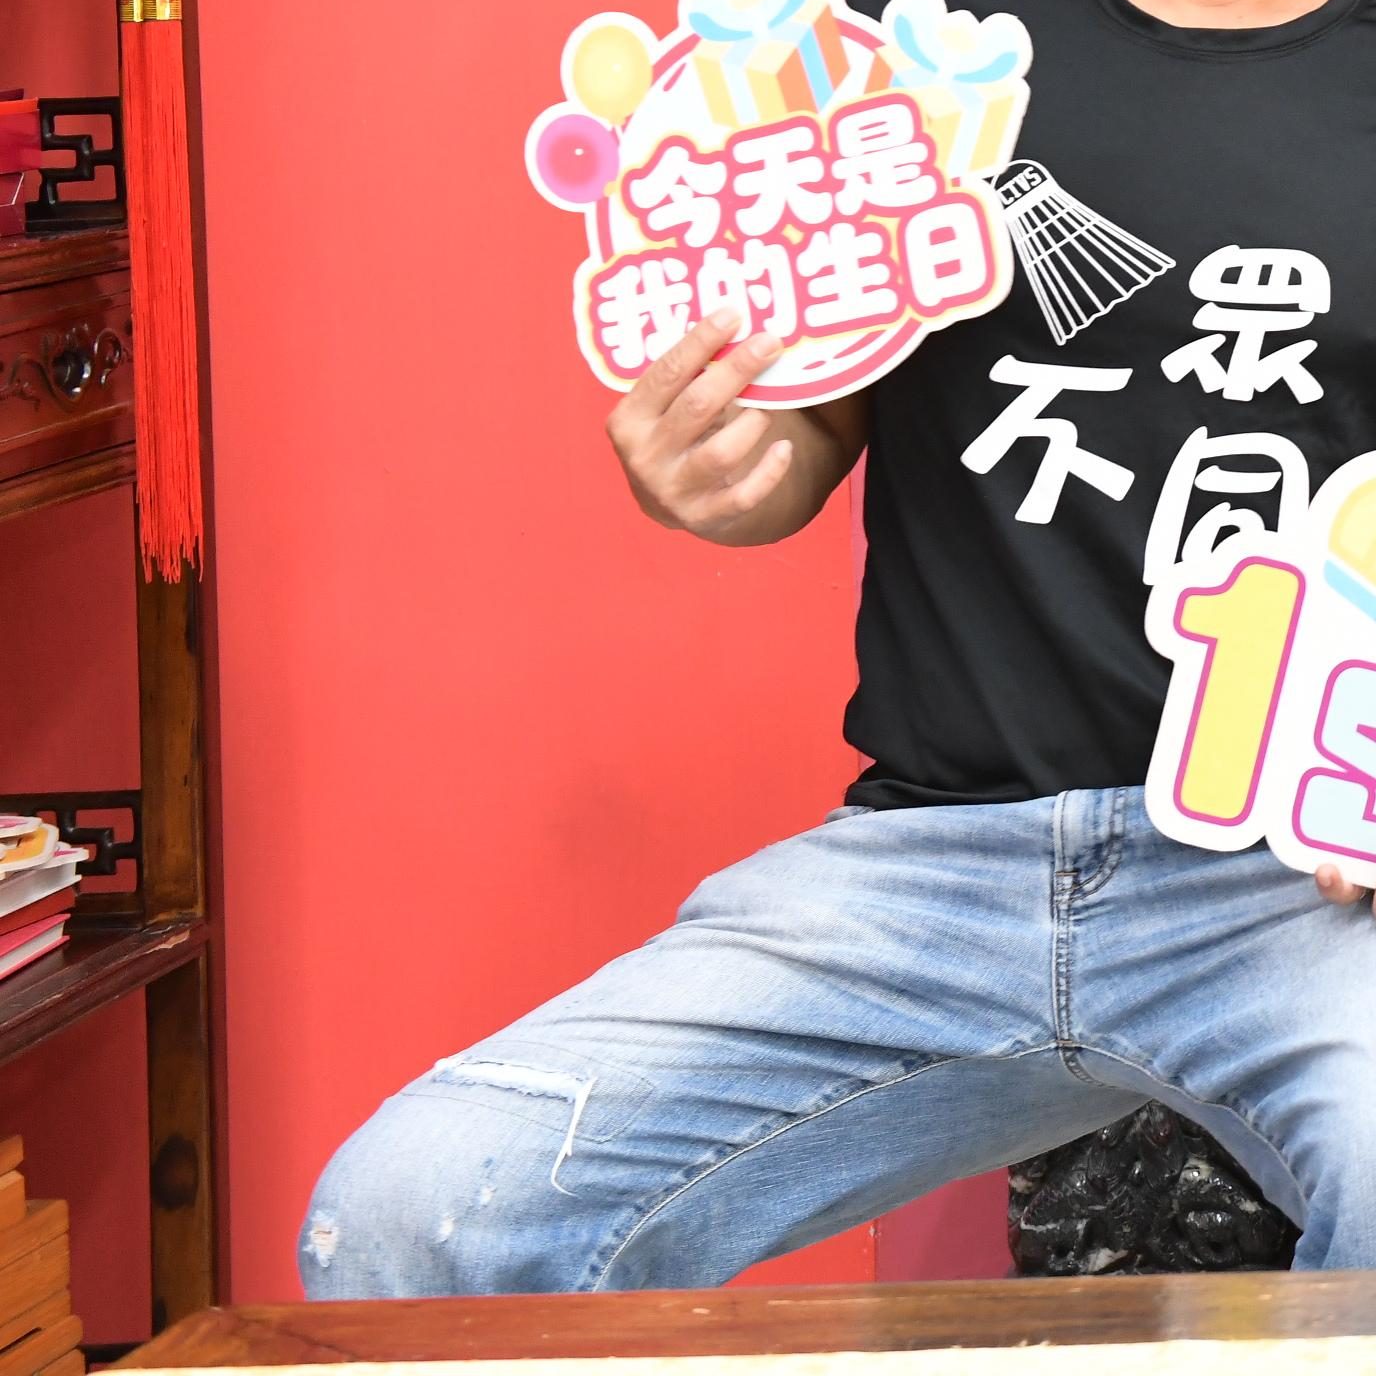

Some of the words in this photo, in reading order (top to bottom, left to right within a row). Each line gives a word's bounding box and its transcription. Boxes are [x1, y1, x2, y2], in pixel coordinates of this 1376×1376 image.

[629, 102, 937, 249] 今天是
[597, 207, 988, 370] 我的生日
